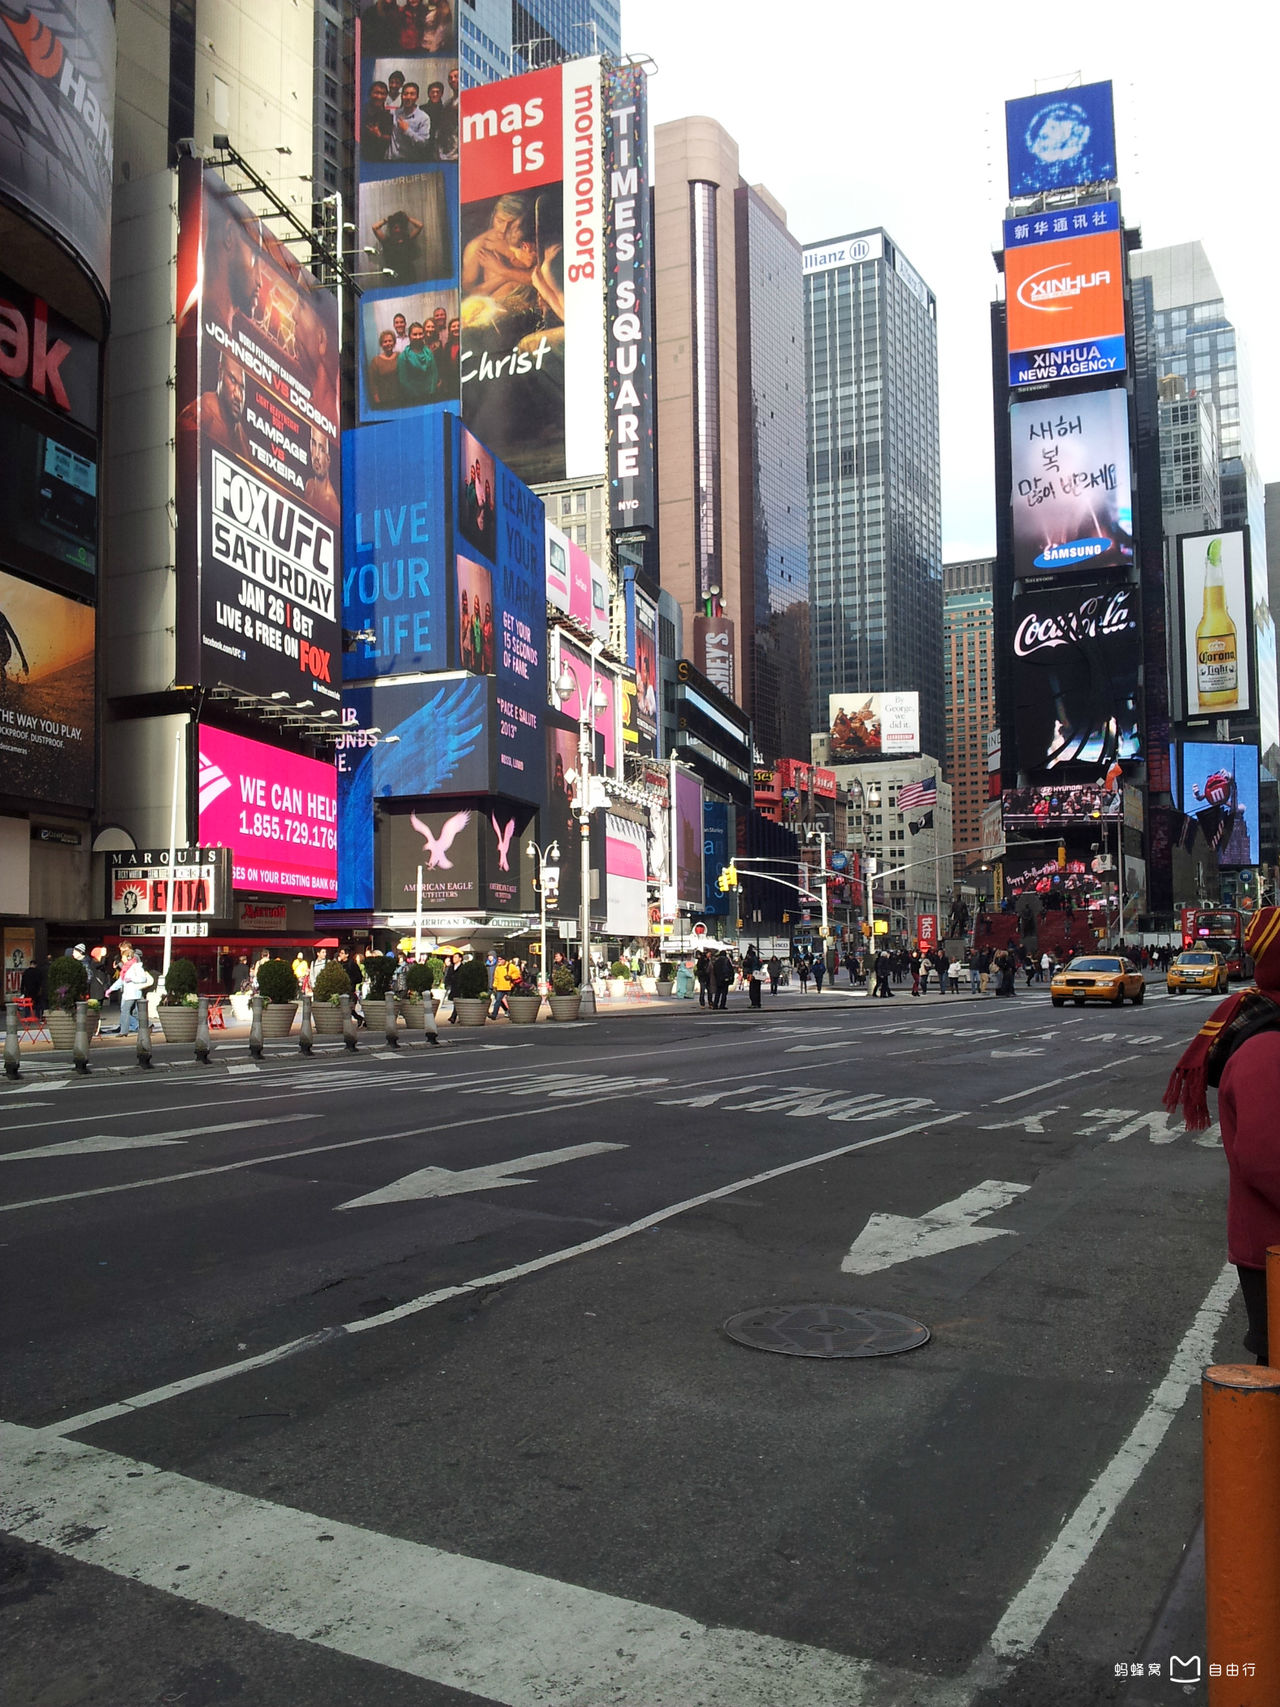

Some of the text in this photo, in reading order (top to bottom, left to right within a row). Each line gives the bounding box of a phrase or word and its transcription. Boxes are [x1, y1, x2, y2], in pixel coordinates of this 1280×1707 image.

[462, 97, 545, 144] mas
[511, 134, 545, 175] is
[568, 84, 594, 283] mormon.org
[1014, 211, 1107, 239] 新华通讯社
[804, 250, 846, 269] llianz
[610, 105, 642, 479] TIMES SQUARE
[1030, 270, 1110, 296] XINHUA
[460, 335, 552, 385] Christ
[1018, 357, 1117, 382] NEWS AGENCY
[1033, 345, 1101, 368] XINHUA
[205, 322, 337, 438] JOHNSON VS DODSON
[246, 407, 308, 466] RAMPAGE
[1029, 415, 1083, 441] 새해
[249, 440, 305, 492] TEIXEIRA
[271, 442, 286, 462] VS
[215, 458, 333, 576] FOX UFC
[617, 500, 640, 511] NYC
[355, 501, 429, 554] LIVE
[214, 521, 333, 614] SATURDAY
[1043, 544, 1102, 561] SAMSUNG
[342, 557, 431, 608] YOUR
[237, 578, 314, 639] JAN 26 8ET
[216, 600, 331, 684] LIVE & FREE ON FOX
[363, 610, 432, 660] LIFE
[502, 610, 532, 643] GET YOUR
[503, 631, 539, 667] 15 SECONDS
[503, 651, 512, 670] OF
[1199, 651, 1235, 665] Corona
[16, 712, 38, 730] WAY
[40, 718, 59, 735] YOU
[61, 724, 82, 741] PLAY.
[239, 774, 337, 823] WE CAN HELP
[112, 850, 216, 864] MARQUIS
[152, 879, 207, 912] EVITA
[247, 868, 259, 882] ON
[260, 869, 279, 884] YOUR
[280, 872, 310, 888] EXISTING
[311, 876, 329, 890] BANK
[403, 882, 473, 892] AMRICAN EAGLE
[422, 891, 459, 899] UTFITTERS
[241, 904, 286, 919] Marriott
[922, 916, 933, 939] tkts
